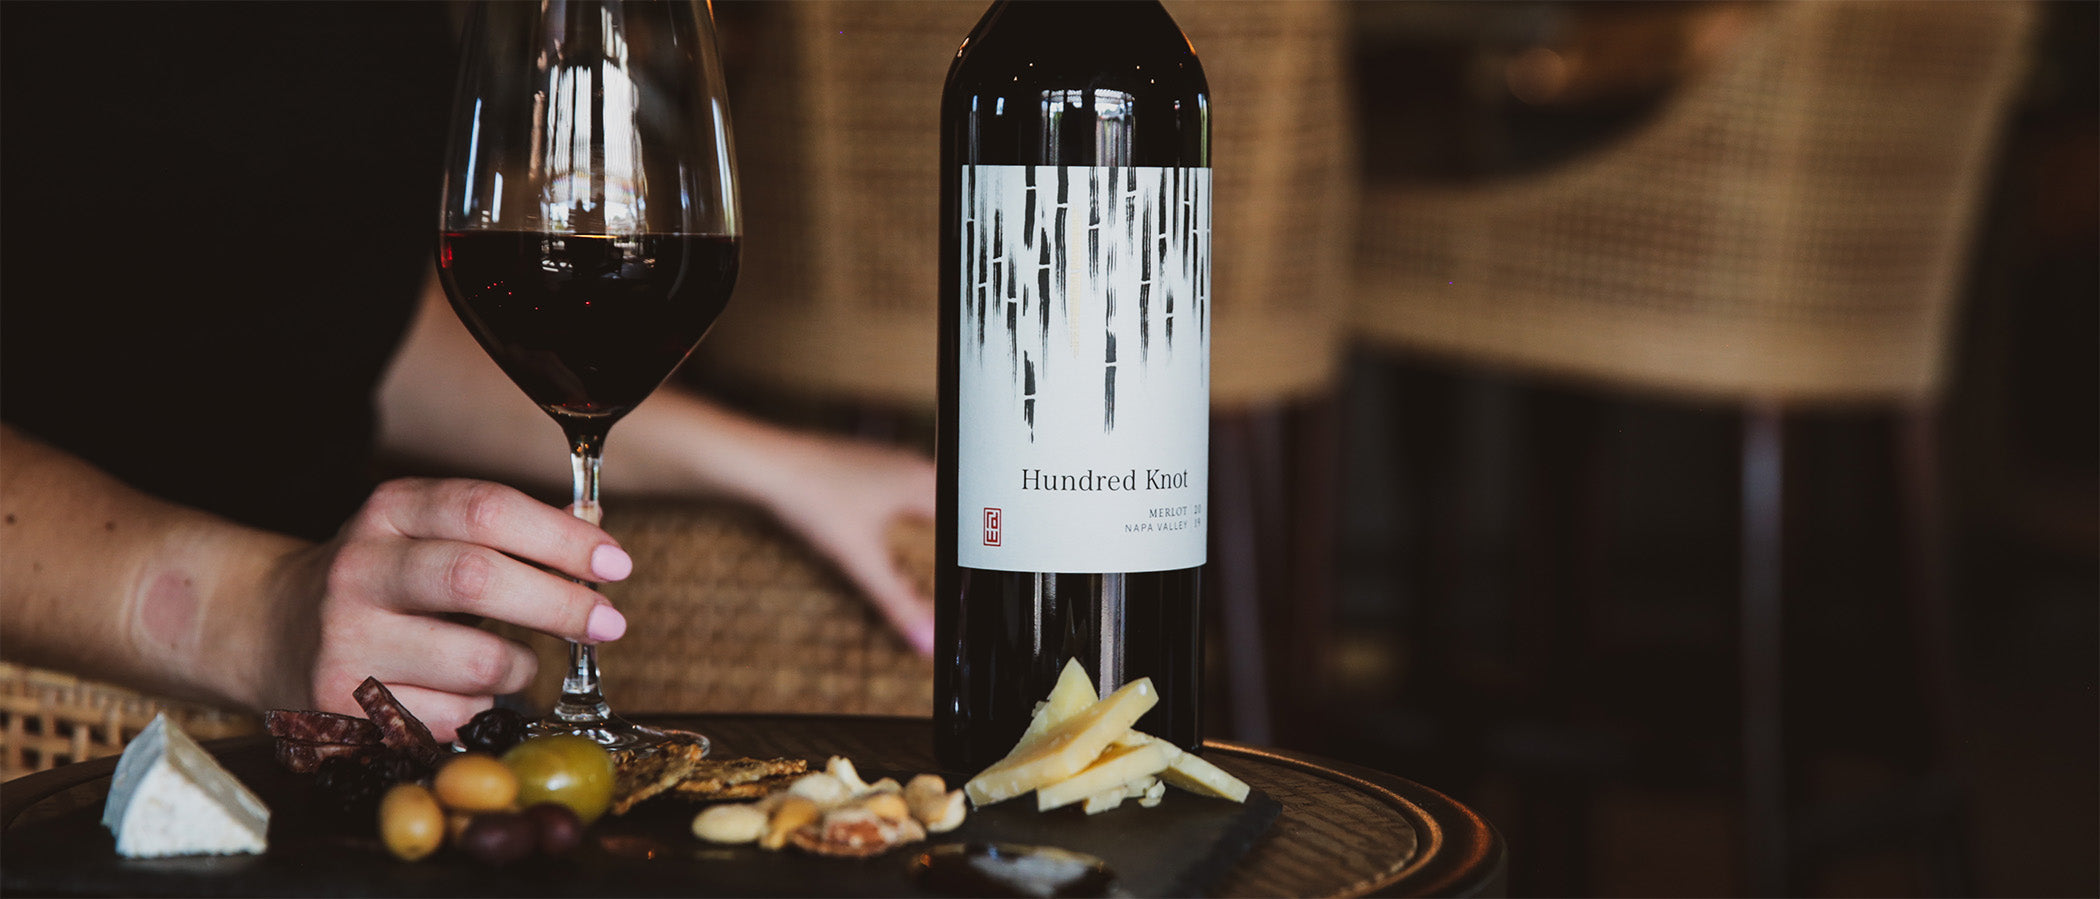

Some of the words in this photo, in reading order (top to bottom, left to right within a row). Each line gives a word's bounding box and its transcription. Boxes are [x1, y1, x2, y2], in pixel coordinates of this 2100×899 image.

[1022, 469, 1136, 491] Hundred
[1146, 469, 1188, 490] Knot
[1149, 506, 1187, 518] MERLOT
[1125, 523, 1153, 532] NAPA
[1157, 520, 1187, 531] VALLEY
